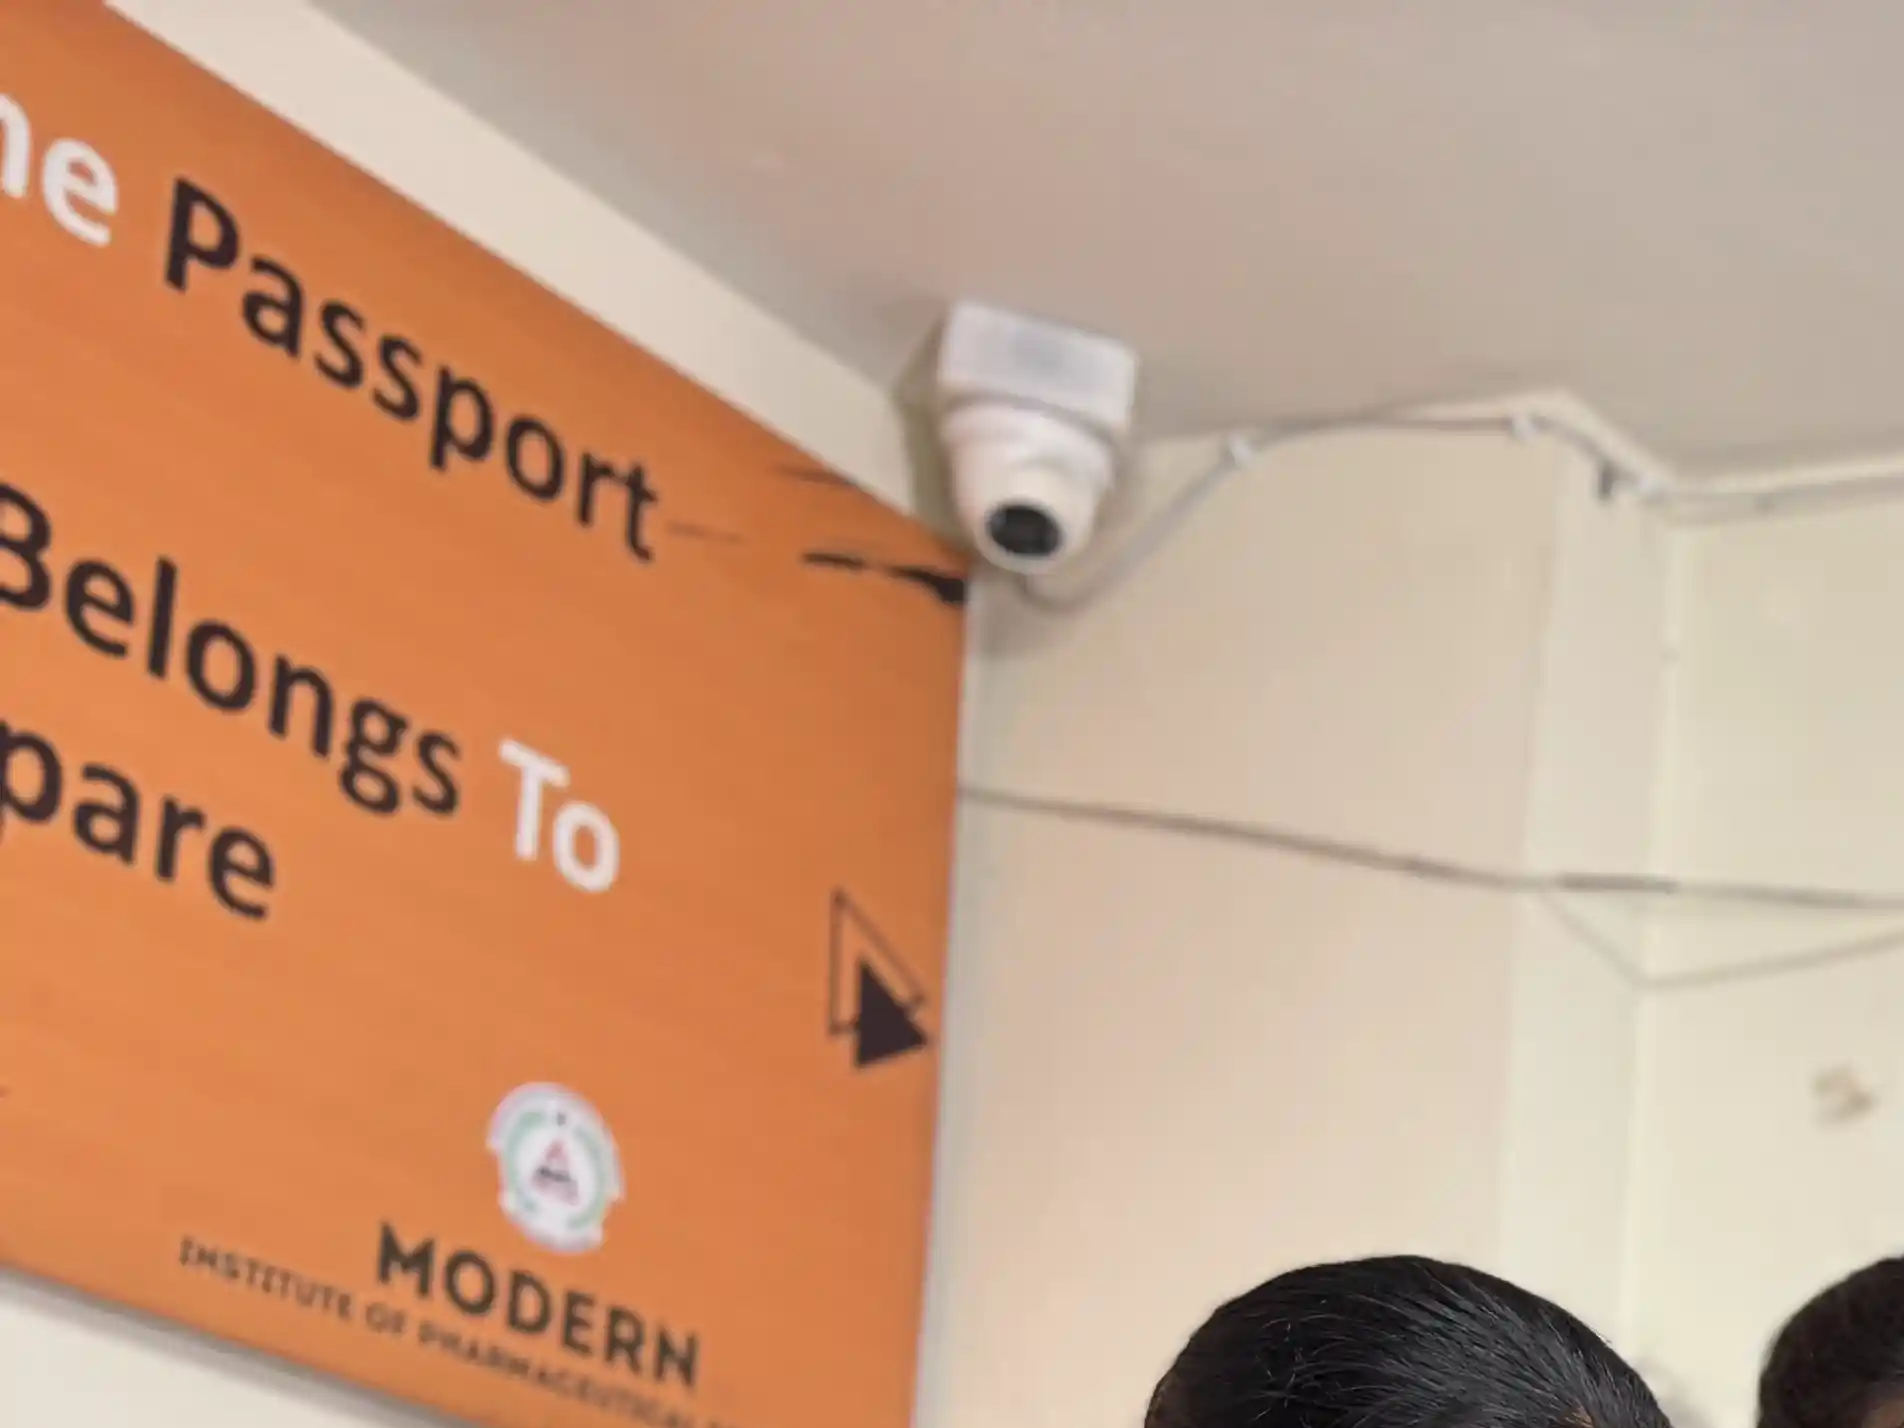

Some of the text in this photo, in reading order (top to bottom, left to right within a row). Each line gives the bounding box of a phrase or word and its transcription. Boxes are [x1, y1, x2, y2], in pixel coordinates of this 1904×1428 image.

[164, 177, 659, 562] Passport
[0, 482, 621, 893] Belongs To
[178, 1235, 354, 1321] INSTITUTE
[377, 1218, 700, 1389] MODERN
